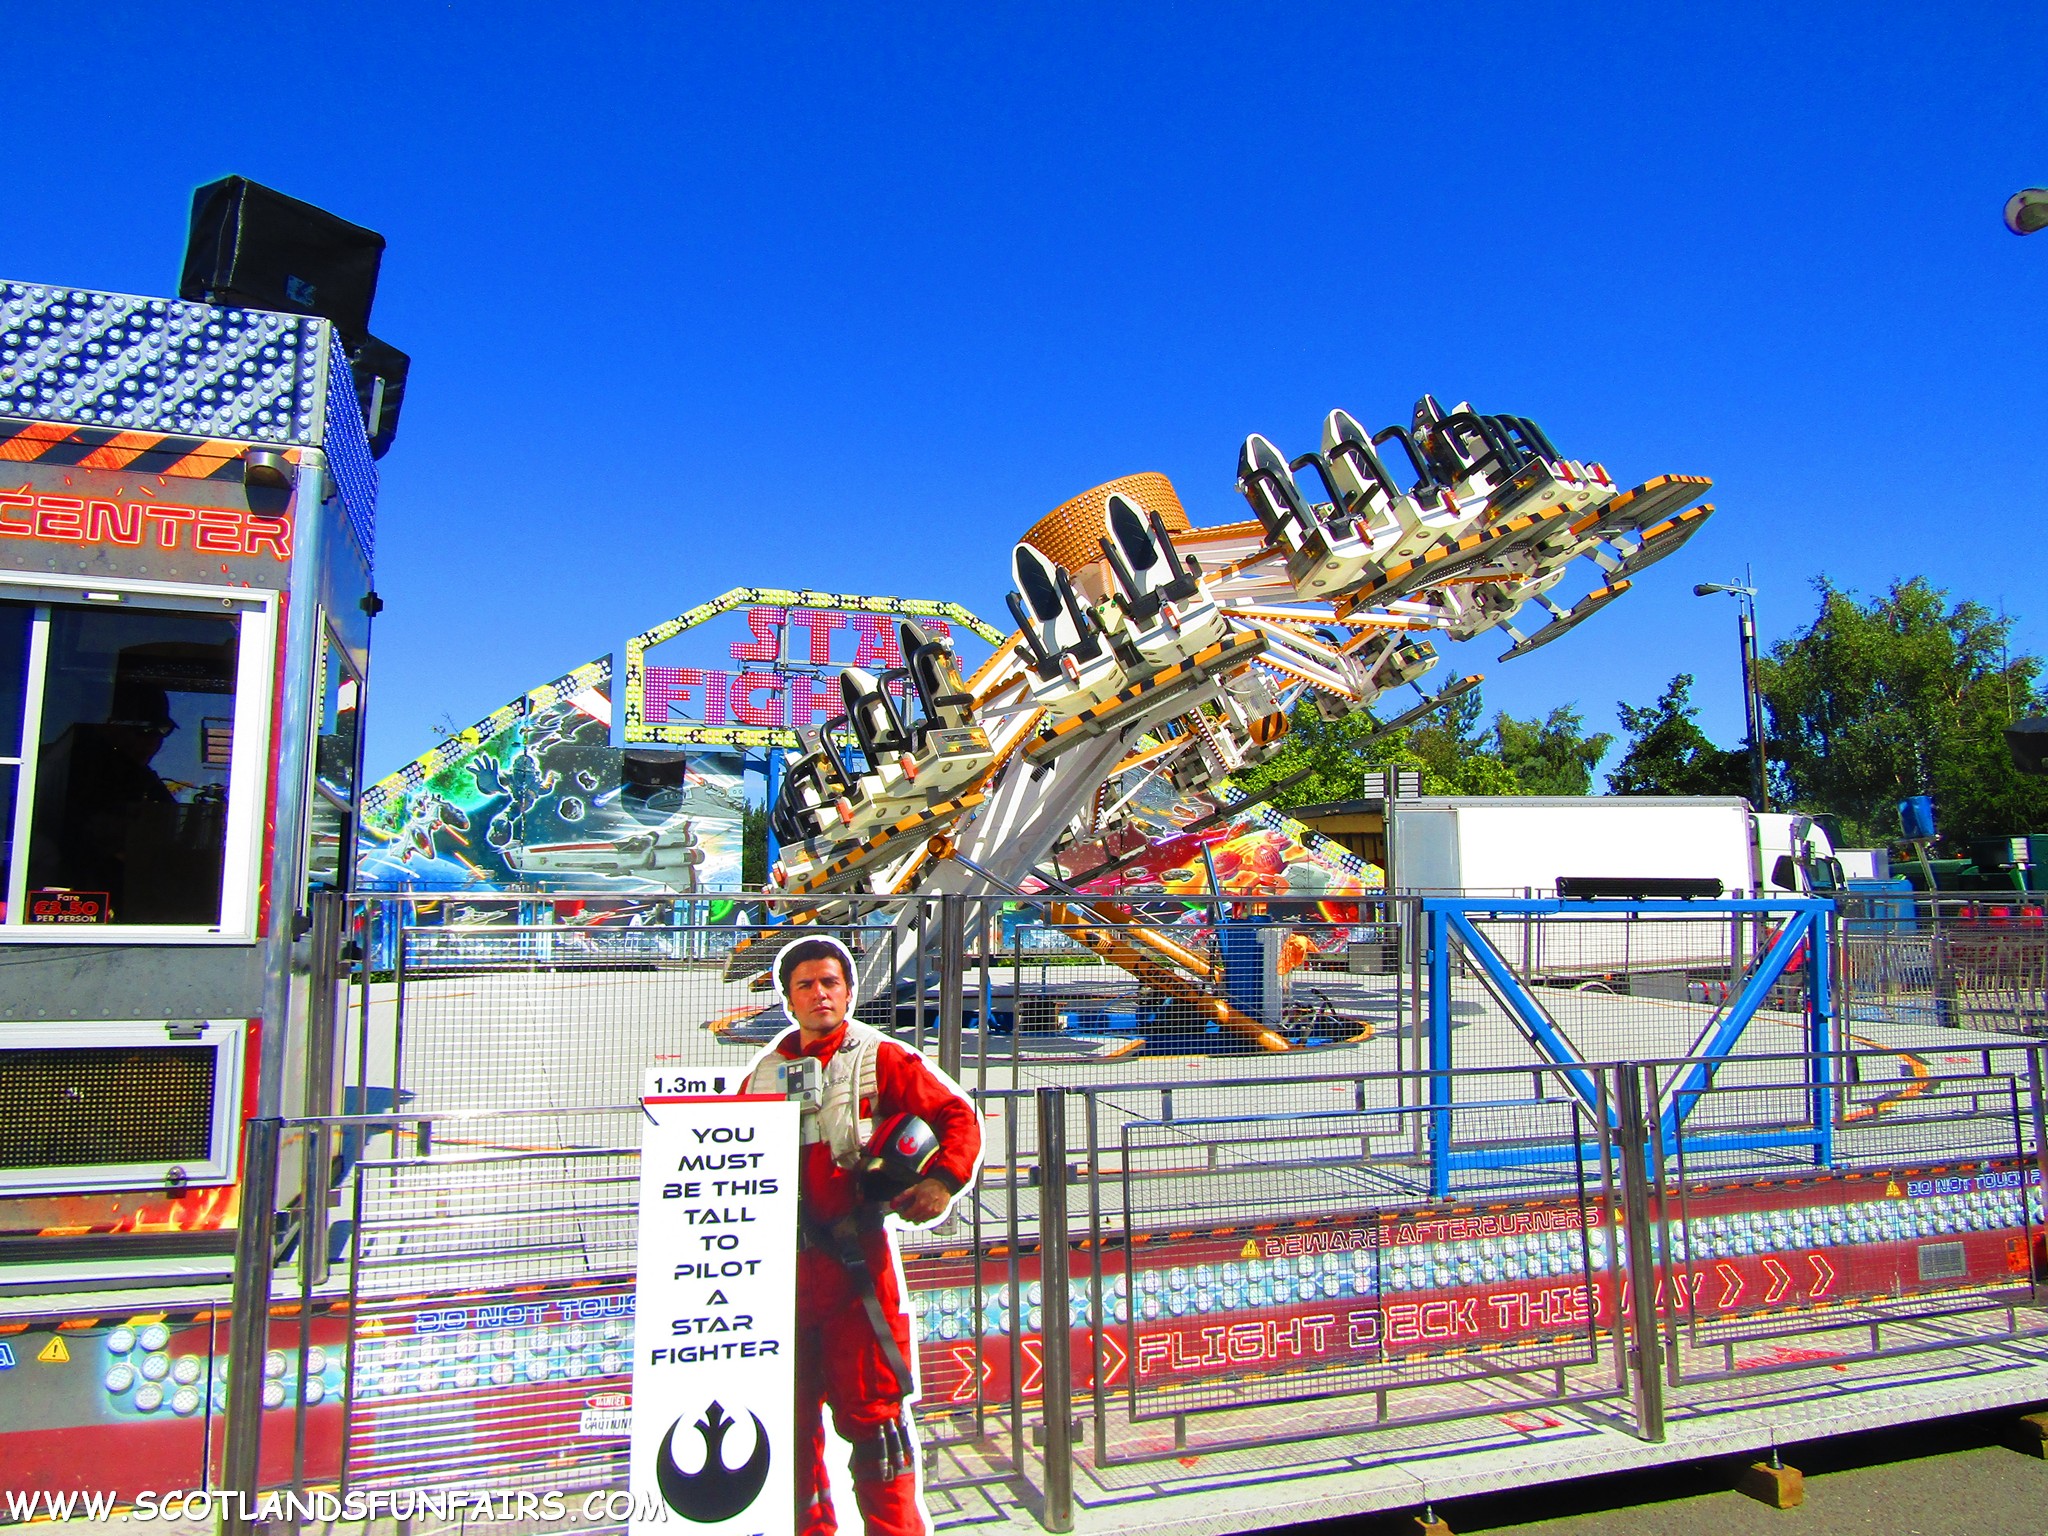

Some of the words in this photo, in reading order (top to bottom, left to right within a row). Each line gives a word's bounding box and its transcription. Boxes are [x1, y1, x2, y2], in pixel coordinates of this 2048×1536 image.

[0, 492, 291, 556] CENTER
[645, 666, 922, 730] FIGH
[57, 893, 80, 901] Fare
[33, 900, 99, 916] £3.50
[36, 914, 54, 922] PER
[57, 914, 97, 923] PERSON
[654, 1077, 707, 1094] 1.3m
[691, 1126, 755, 1144] YOU
[678, 1152, 765, 1172] MUST
[662, 1182, 702, 1199] BE
[712, 1178, 779, 1197] THIS
[683, 1206, 757, 1225] TALL
[1265, 1225, 1391, 1258] BEWARE
[1396, 1206, 1600, 1244] AFTERBURNERS
[699, 1234, 740, 1251] TO
[673, 1259, 763, 1281] PILOT
[705, 1289, 730, 1306] A
[416, 1310, 468, 1334] DO
[476, 1302, 550, 1328] NOT
[557, 1295, 636, 1320] TOUC
[671, 1314, 754, 1336] STAR
[1138, 1314, 1335, 1374] FLIGHT
[1348, 1297, 1479, 1349] DECK
[1488, 1282, 1601, 1328] THIS
[651, 1339, 780, 1366] FIGHTER
